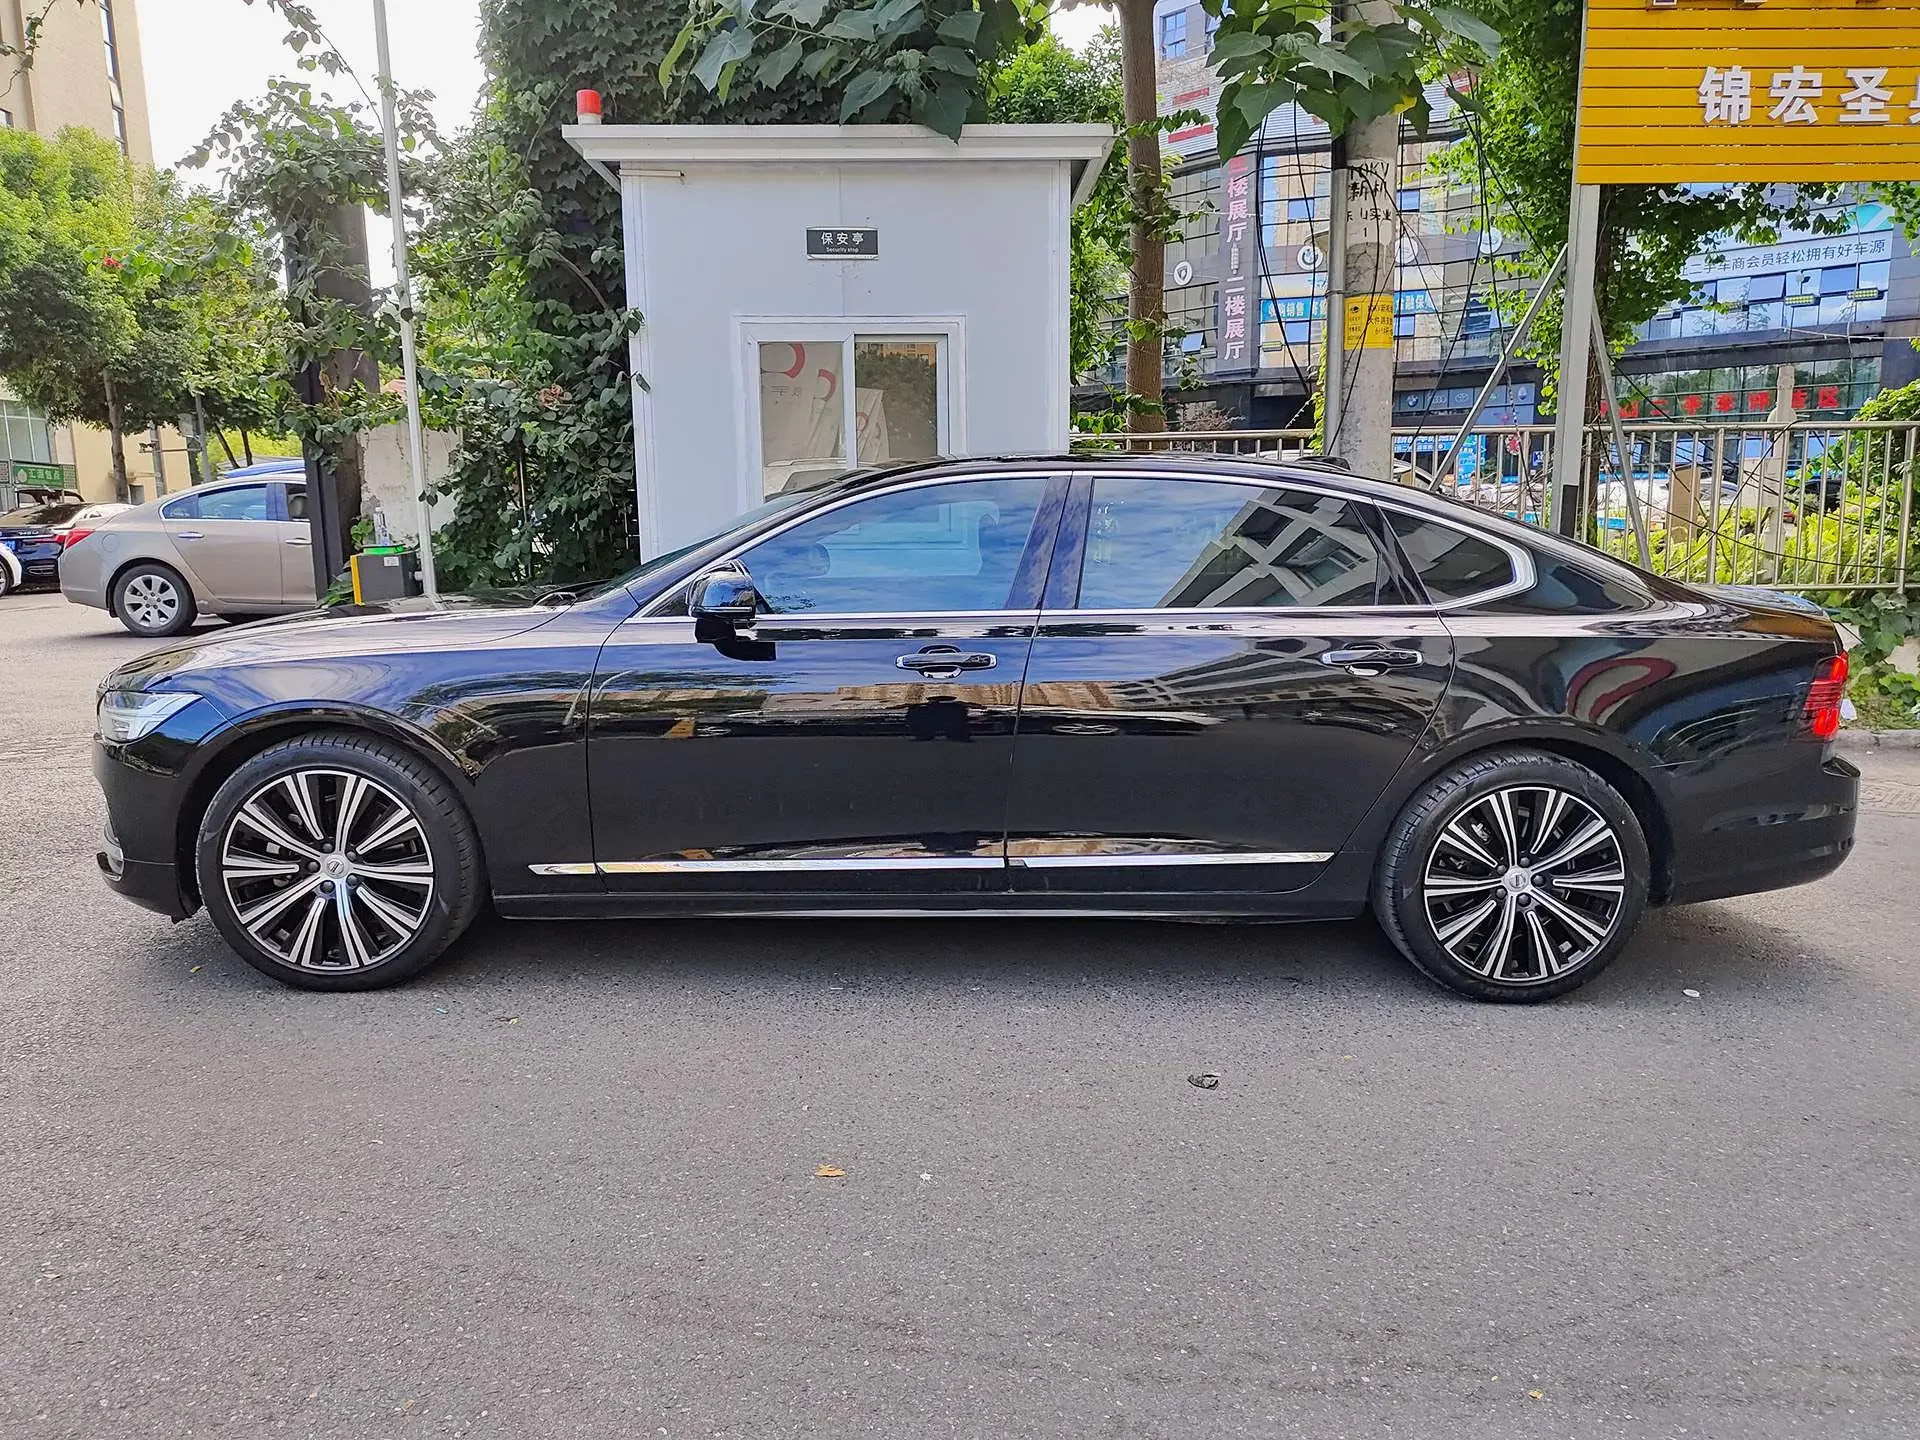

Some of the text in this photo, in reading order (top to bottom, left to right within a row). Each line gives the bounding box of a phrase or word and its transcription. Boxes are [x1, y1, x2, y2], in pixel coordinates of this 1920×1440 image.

[821, 232, 863, 245] 保安亭
[1224, 276, 1246, 361] 二楼展厅
